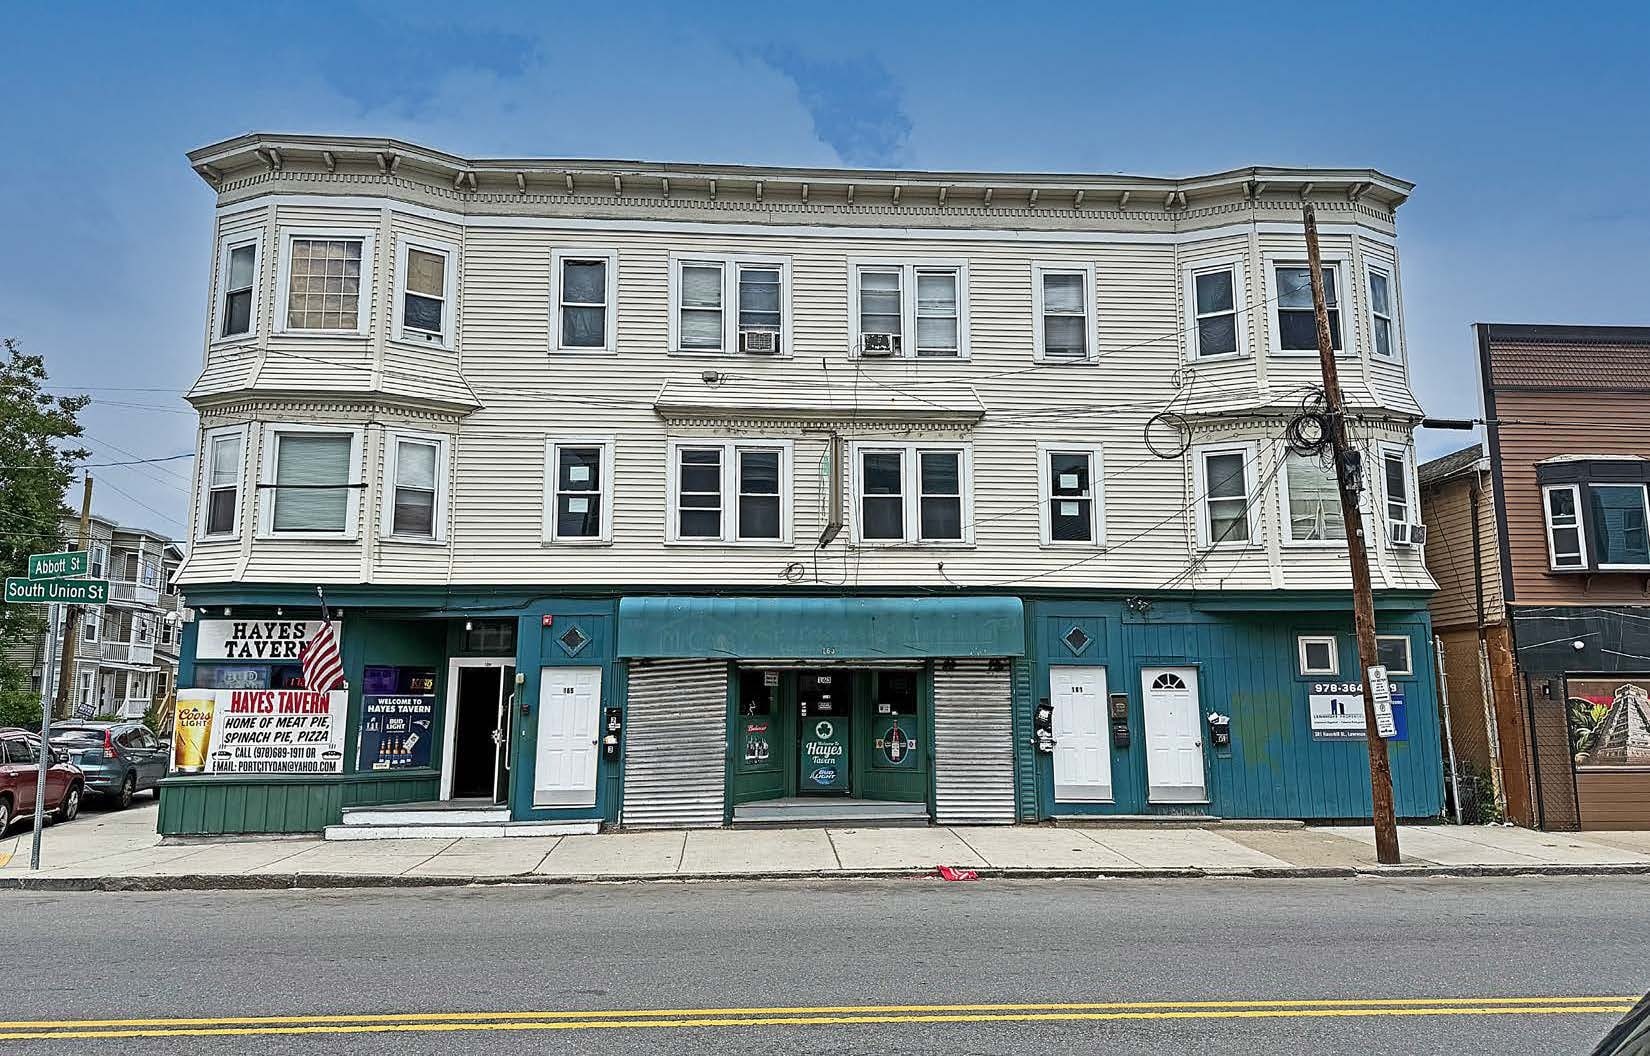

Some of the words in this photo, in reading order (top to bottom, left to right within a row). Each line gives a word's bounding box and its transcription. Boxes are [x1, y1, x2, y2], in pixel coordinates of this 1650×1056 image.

[35, 559, 66, 574] Abbott
[70, 557, 80, 570] St
[9, 582, 45, 597] South
[49, 583, 86, 598] Union
[88, 585, 104, 599] St
[232, 622, 306, 639] HAYES
[230, 691, 275, 714] HAYES
[278, 692, 331, 714] TAVERN
[367, 705, 396, 713] HAYES
[398, 705, 431, 713] TAVERN
[179, 709, 211, 720] Coors
[224, 717, 258, 729] HOME
[259, 717, 274, 728] OF
[275, 717, 309, 728] MEAT
[309, 716, 330, 729] PIE,
[224, 732, 271, 744] SPINACH
[273, 731, 294, 744] PIE,
[299, 731, 329, 742] PIZZA
[235, 748, 252, 758] CALL
[254, 747, 304, 758] (978)689-1911
[306, 748, 316, 758] OR
[806, 742, 842, 758] Hayes
[212, 761, 237, 772] EMAIL:
[239, 761, 336, 772] PORTCITYDAN@YAHOO.COM
[812, 756, 836, 764] Tavern
